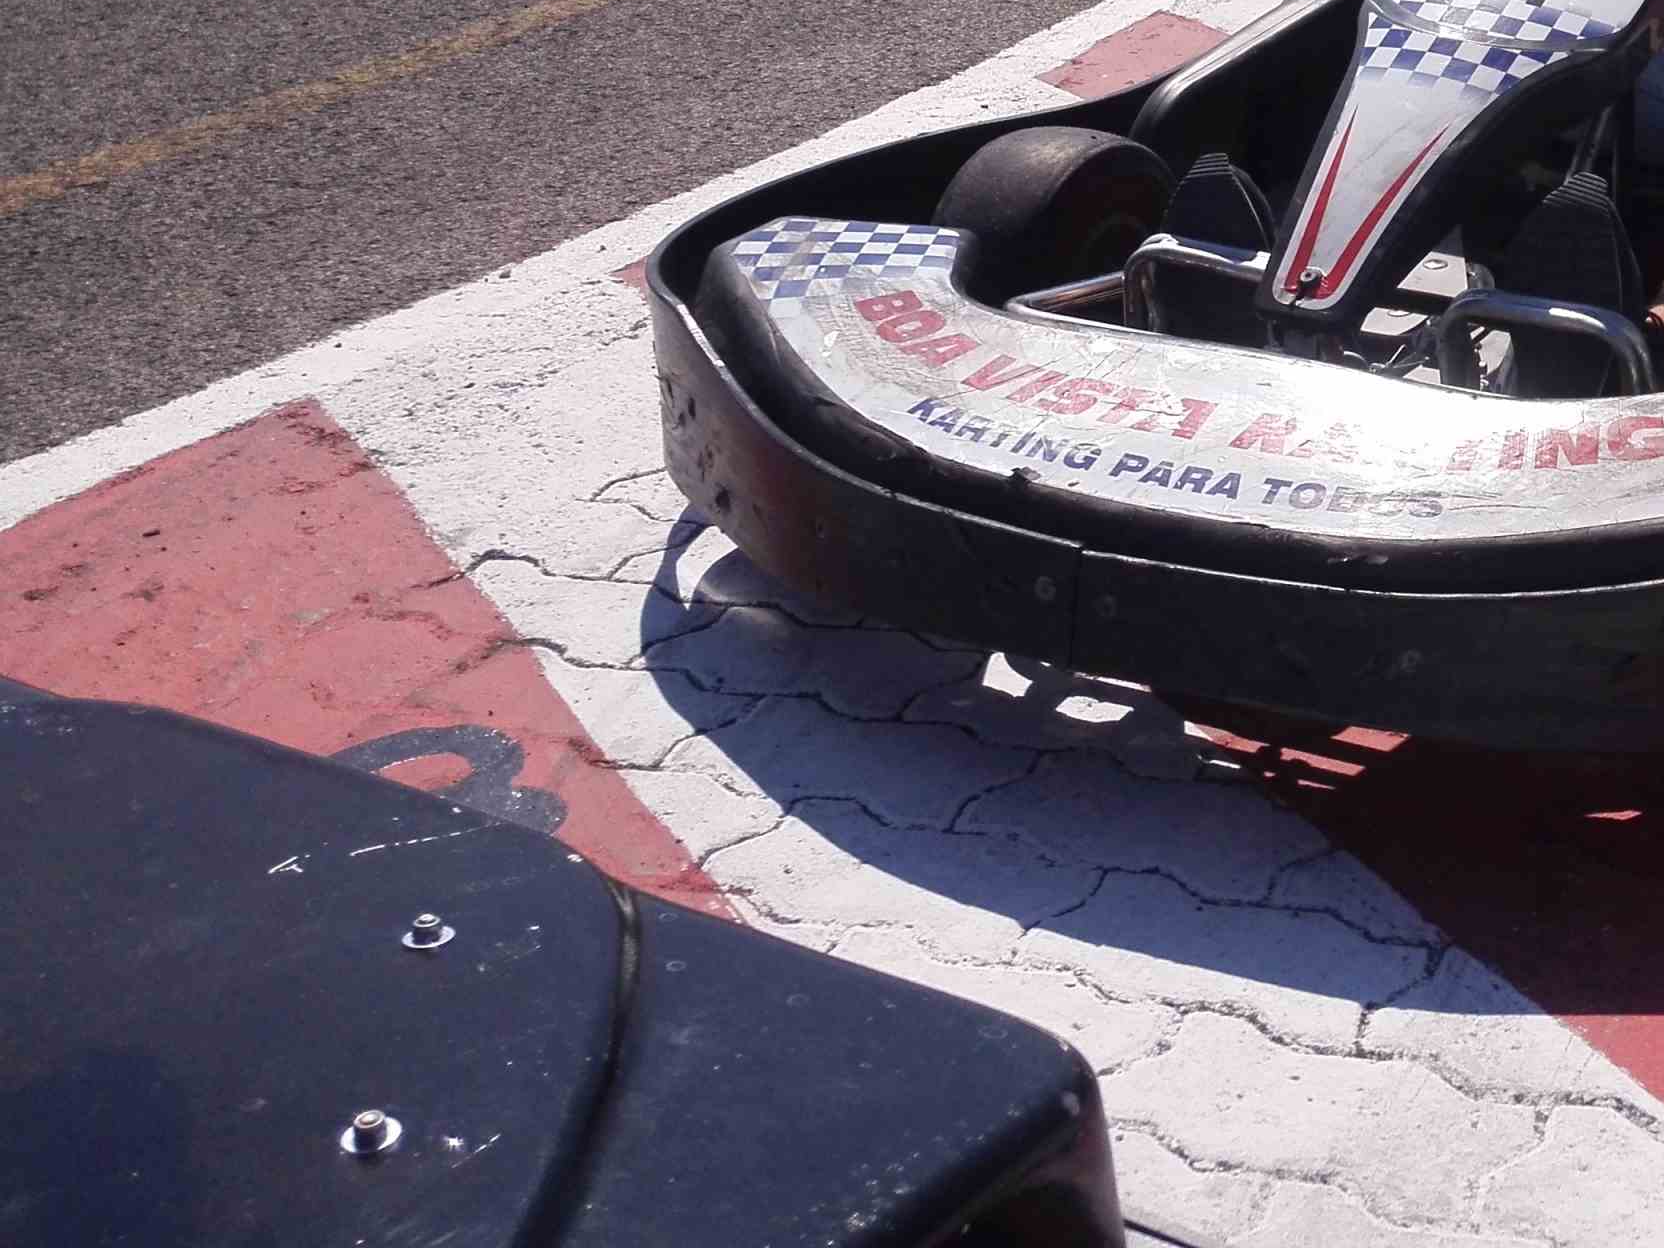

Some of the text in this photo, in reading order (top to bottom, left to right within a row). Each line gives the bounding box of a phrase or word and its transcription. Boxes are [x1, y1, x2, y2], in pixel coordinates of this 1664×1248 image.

[854, 289, 978, 369] BOA
[907, 398, 1102, 472] KARTING
[1108, 453, 1241, 500] PARA
